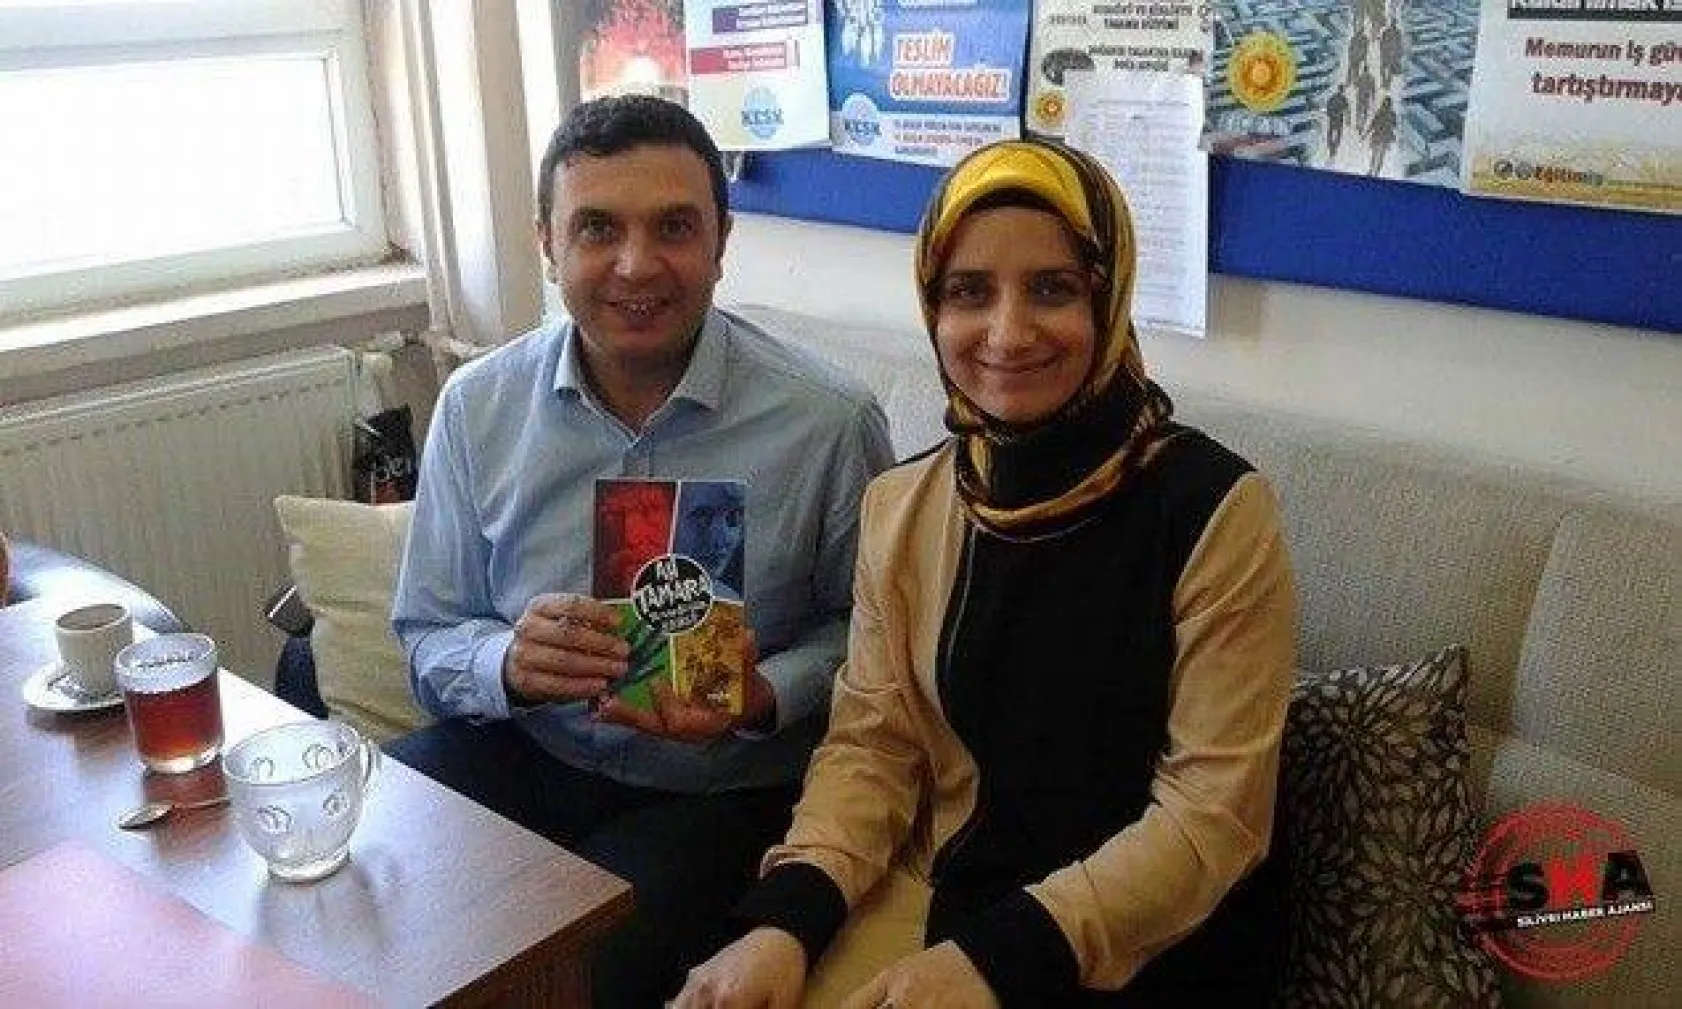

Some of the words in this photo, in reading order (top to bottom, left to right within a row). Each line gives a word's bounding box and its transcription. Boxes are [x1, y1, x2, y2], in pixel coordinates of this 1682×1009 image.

[1525, 37, 1621, 59] Memurun
[1649, 42, 1682, 66] gü
[741, 109, 784, 125] KESK
[843, 120, 882, 136] KESK
